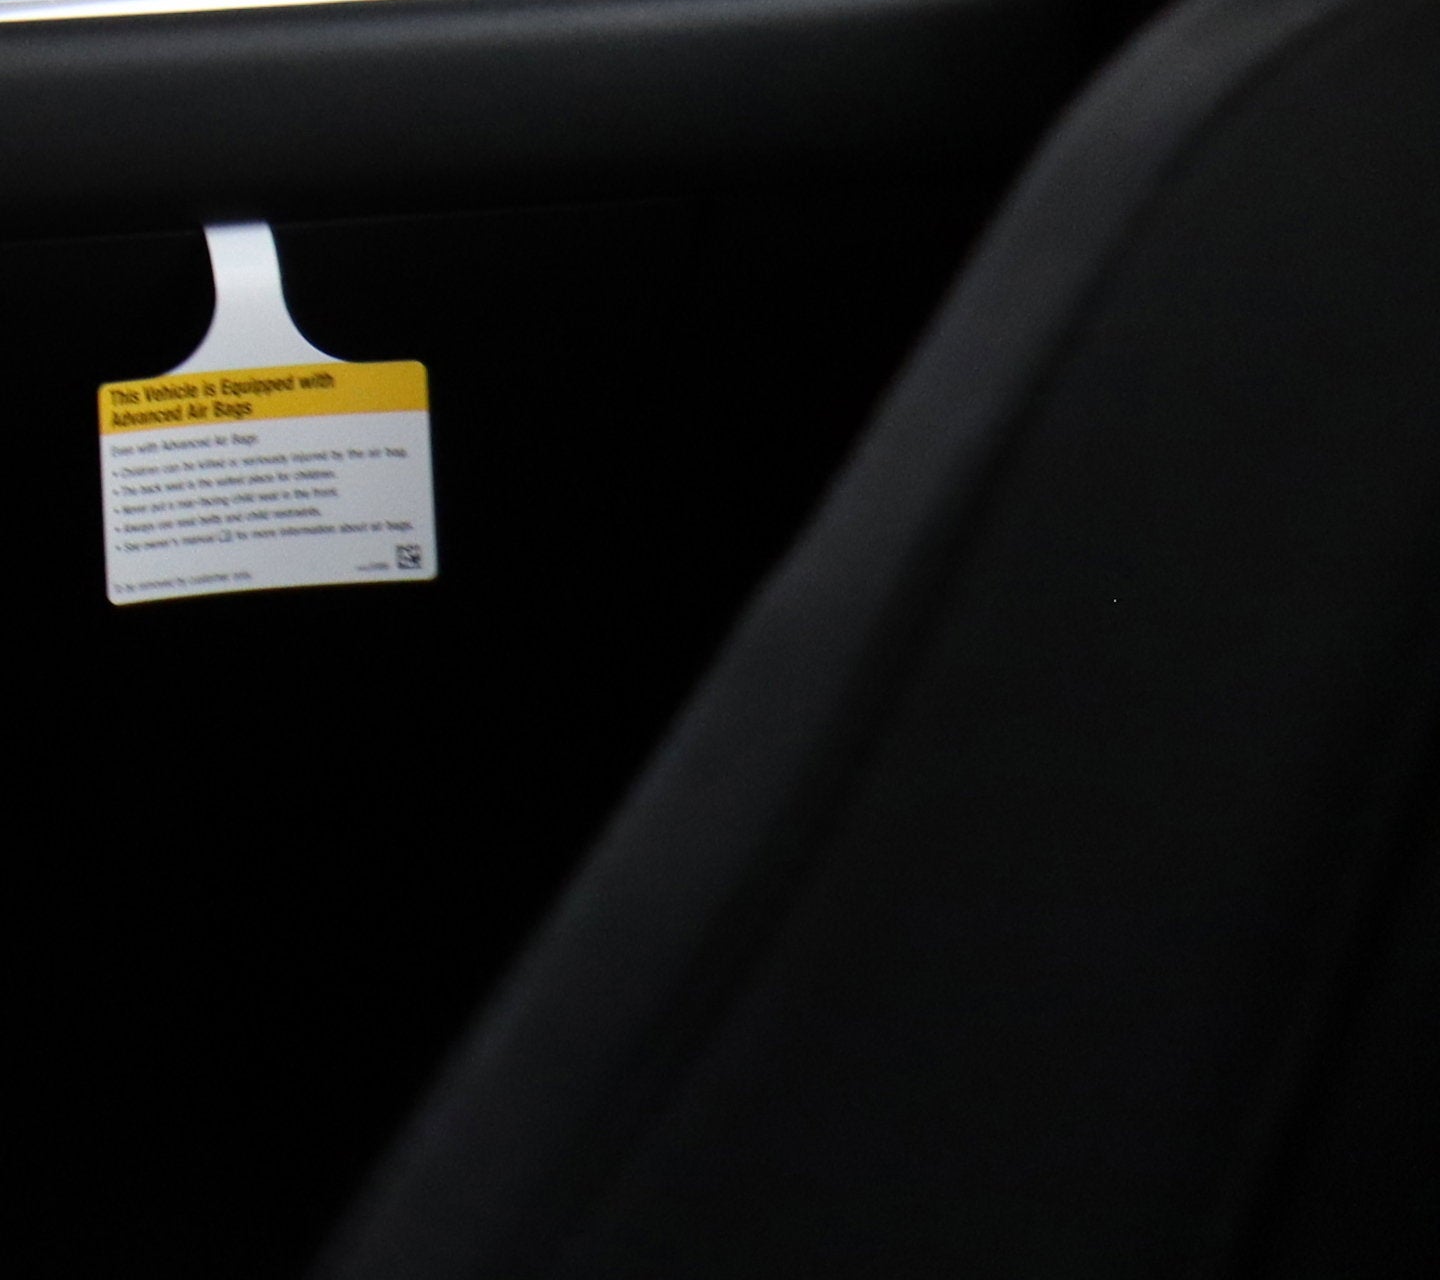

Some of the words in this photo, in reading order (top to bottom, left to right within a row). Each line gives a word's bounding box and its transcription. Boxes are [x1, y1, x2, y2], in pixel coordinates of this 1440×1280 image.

[110, 388, 140, 405] This
[143, 383, 199, 402] Vehicle
[202, 380, 217, 397] is
[220, 374, 295, 397] Equipped
[298, 371, 336, 389] with
[112, 405, 183, 427] Advanced
[187, 402, 208, 419] Air
[213, 399, 254, 420] Bags
